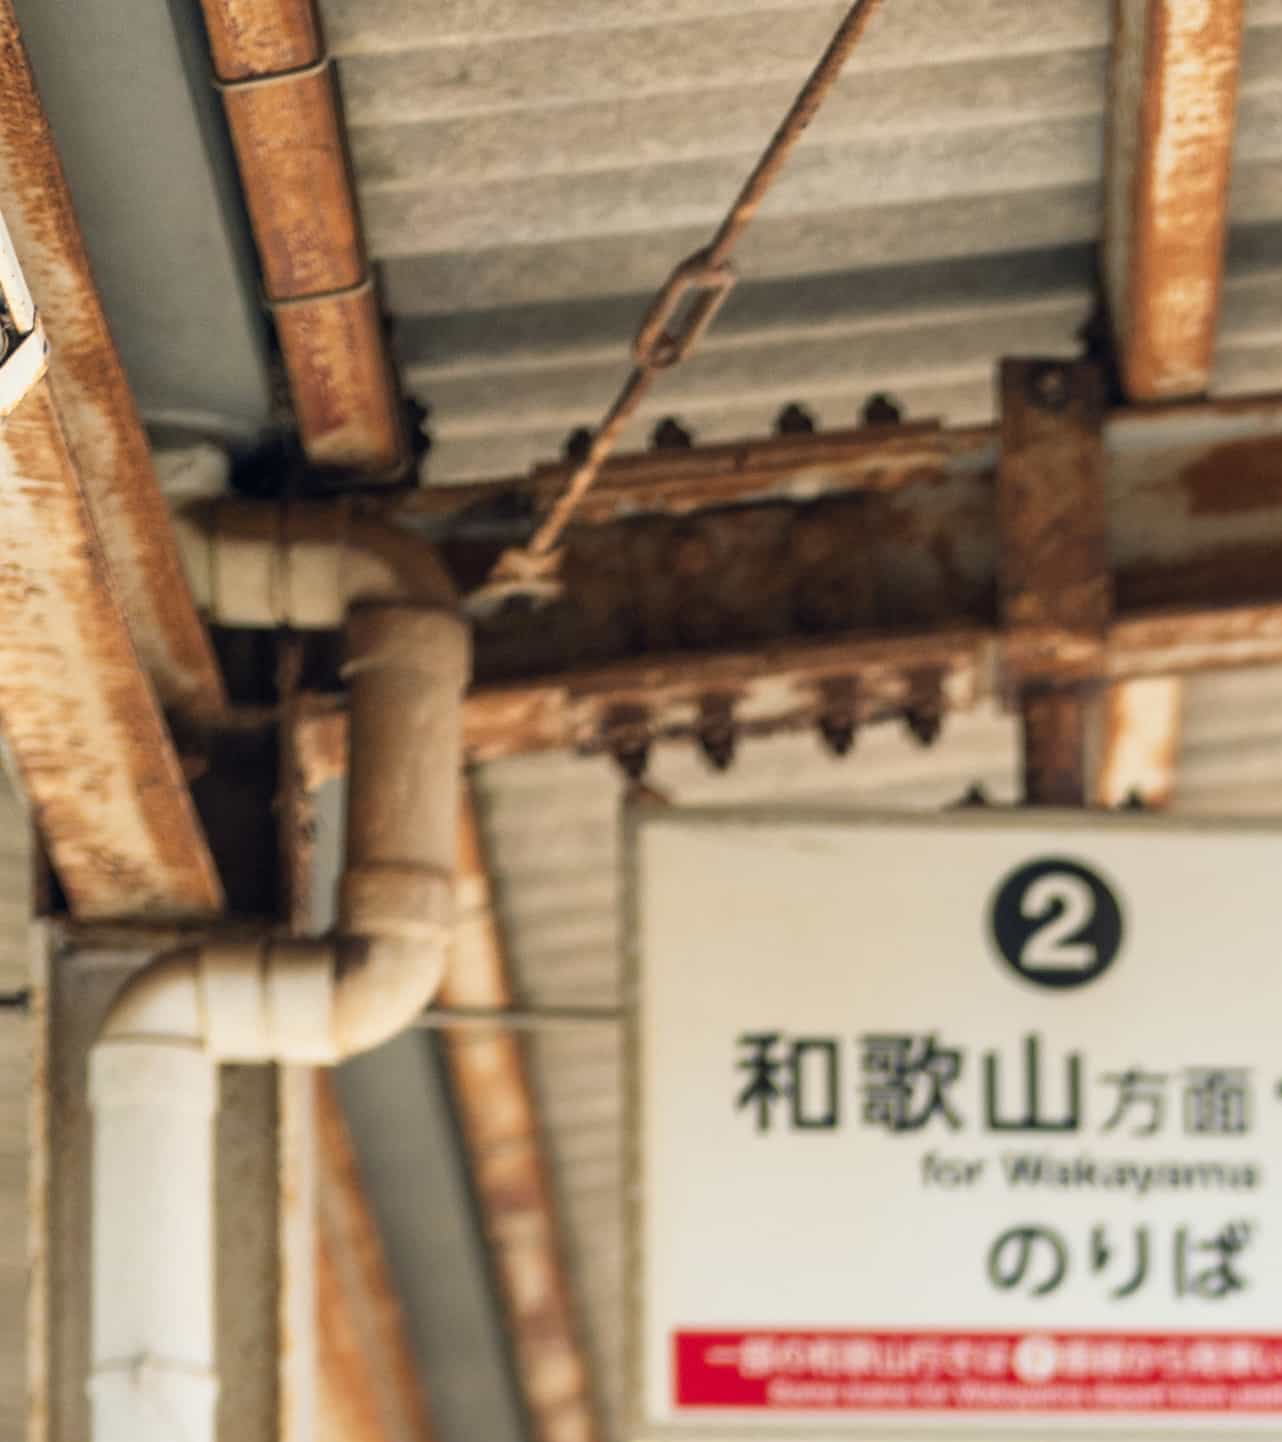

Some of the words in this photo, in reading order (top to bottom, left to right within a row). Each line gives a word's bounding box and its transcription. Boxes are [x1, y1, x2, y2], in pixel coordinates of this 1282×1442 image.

[1018, 872, 1099, 971] 2
[736, 1030, 1254, 1136] 和歌山方面
[921, 1151, 984, 1188] for
[1001, 1152, 1261, 1196] Wakayama
[985, 1221, 1253, 1300] のりば
